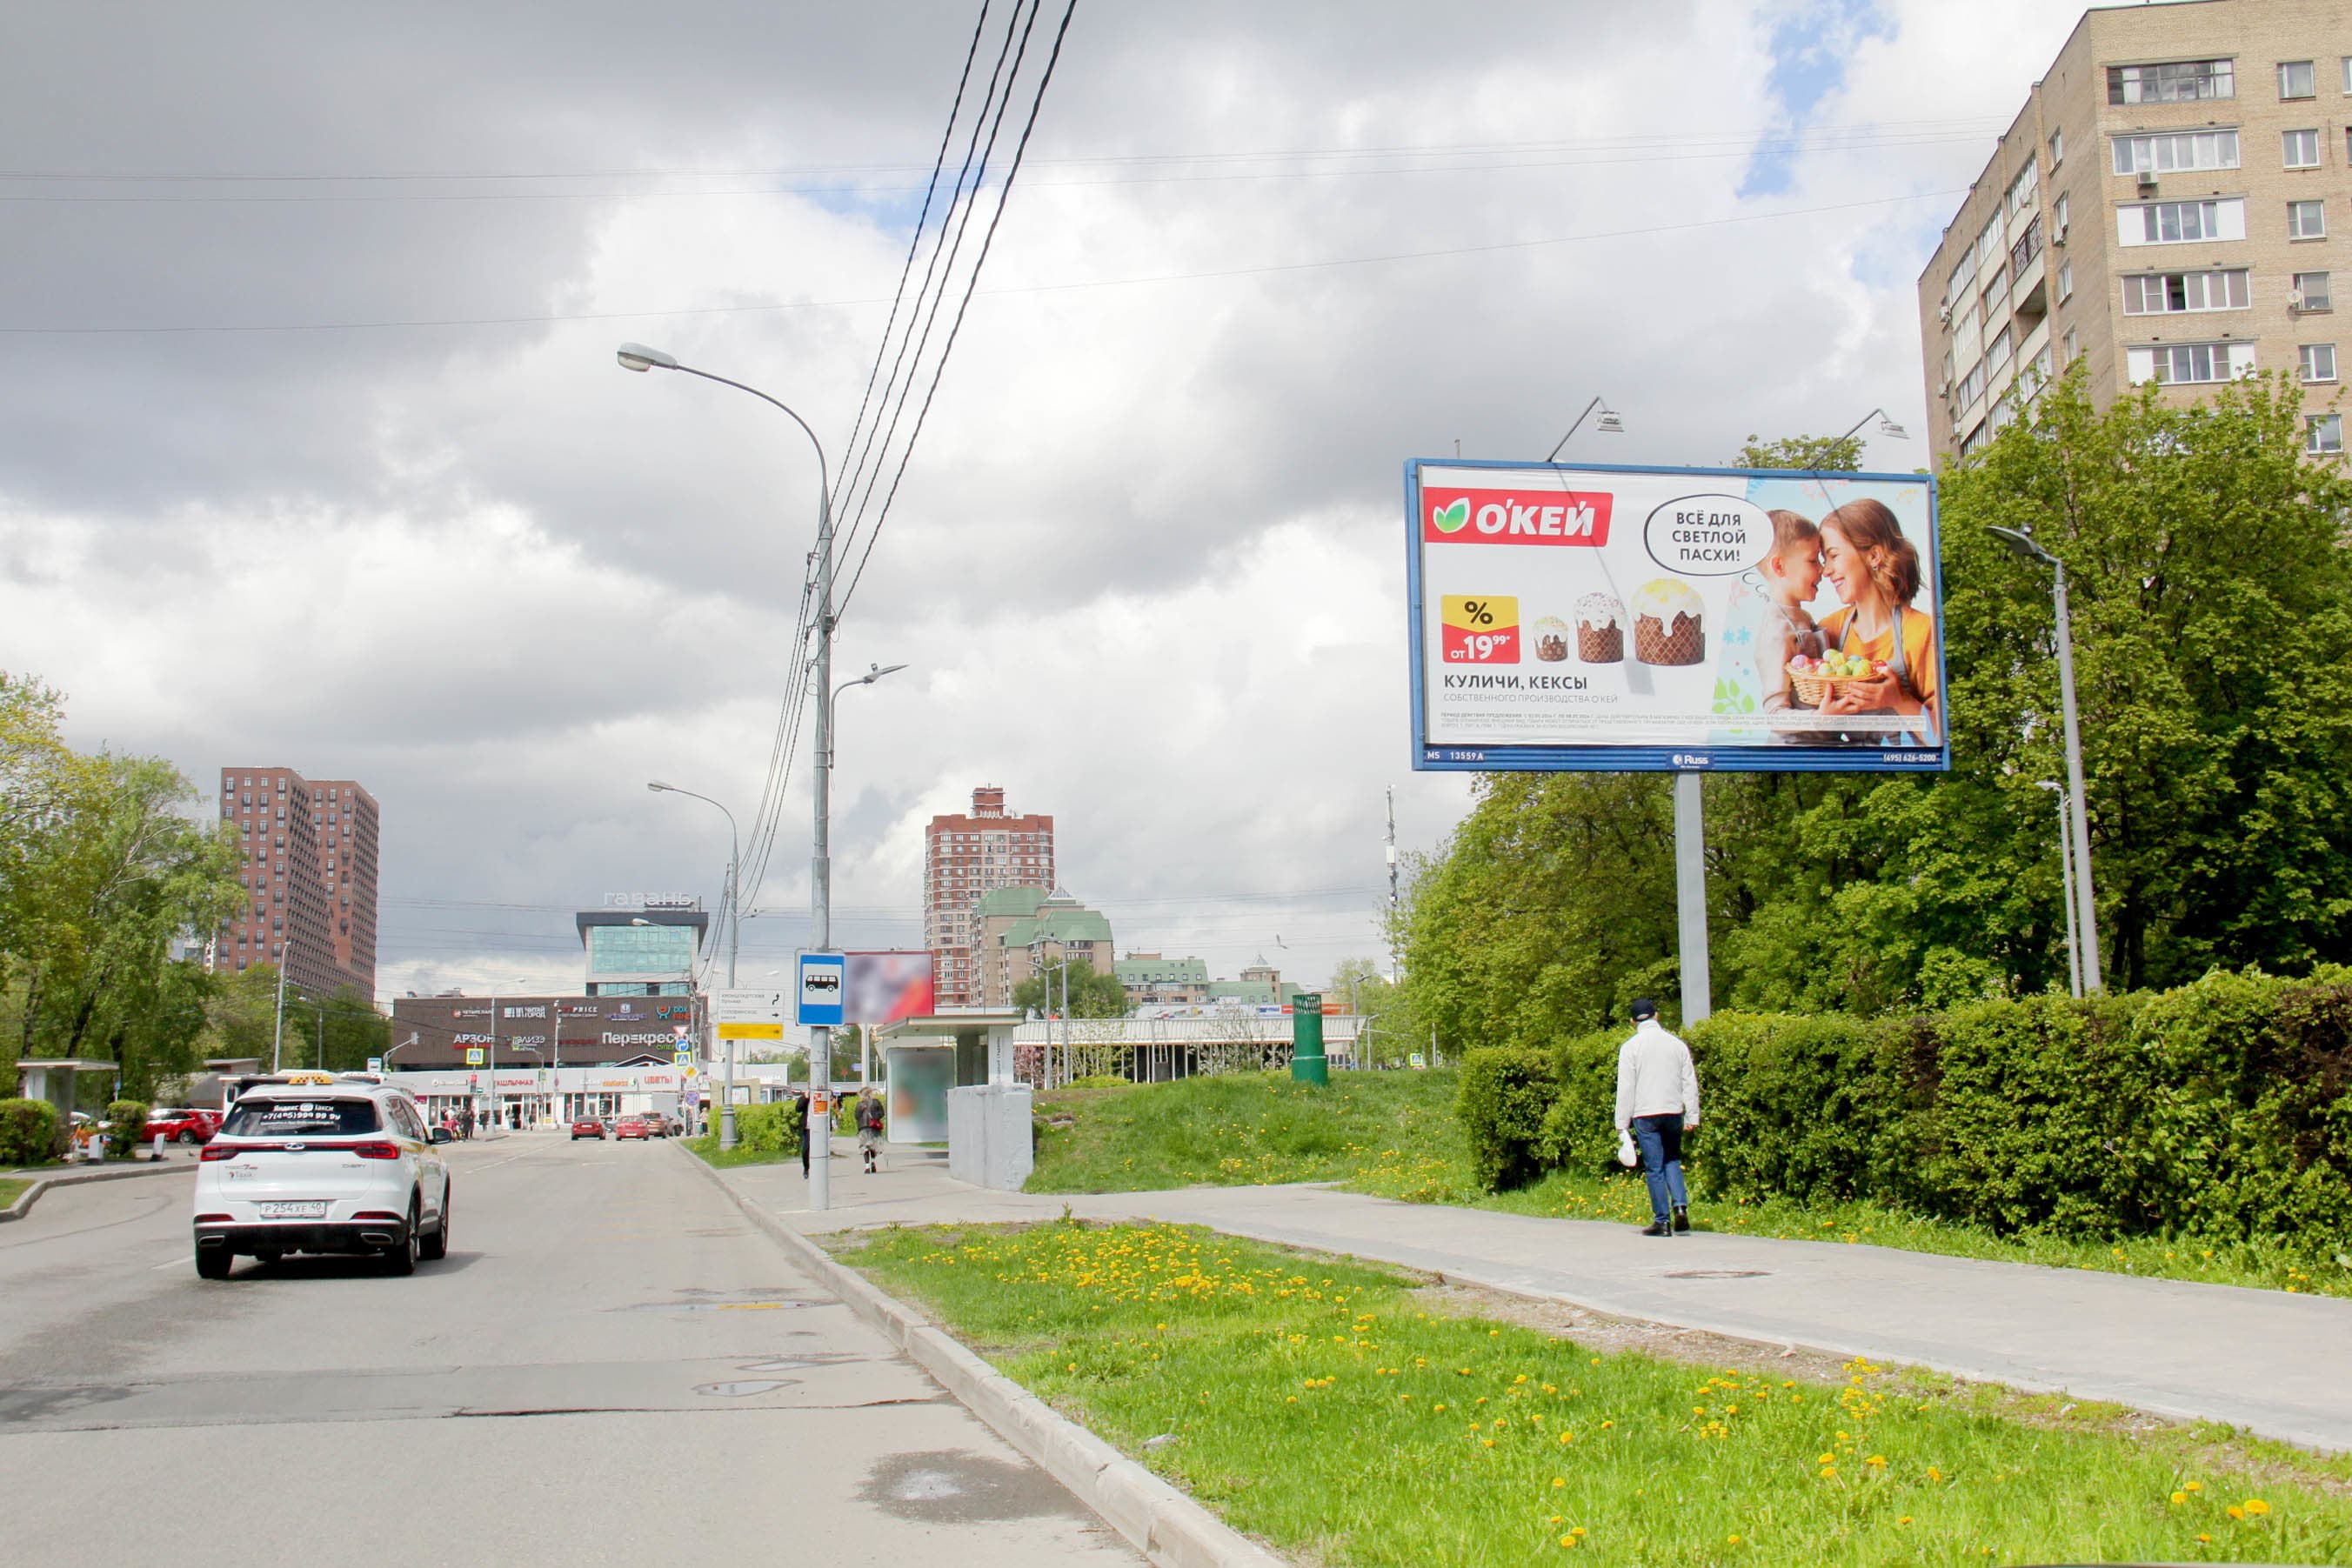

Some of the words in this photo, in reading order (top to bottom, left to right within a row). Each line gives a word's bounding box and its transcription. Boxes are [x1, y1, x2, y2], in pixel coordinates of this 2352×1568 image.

[1676, 510, 1704, 524] ВСЁ
[1708, 513, 1741, 527] ДЛЯ
[1672, 529, 1746, 544] СВЕТЛОЙ
[1680, 548, 1741, 561] ПАСХИ!
[1464, 601, 1493, 624] %
[1444, 674, 1525, 691] КУЛИЧИ,
[1528, 676, 1587, 690] КЕКСЫ
[1443, 693, 1516, 703] СОБСТВЕННОГО
[1518, 694, 1590, 704] ПРОИЗВОДСТВА
[1684, 755, 1709, 764] Russ
[1883, 753, 1902, 763] (495)
